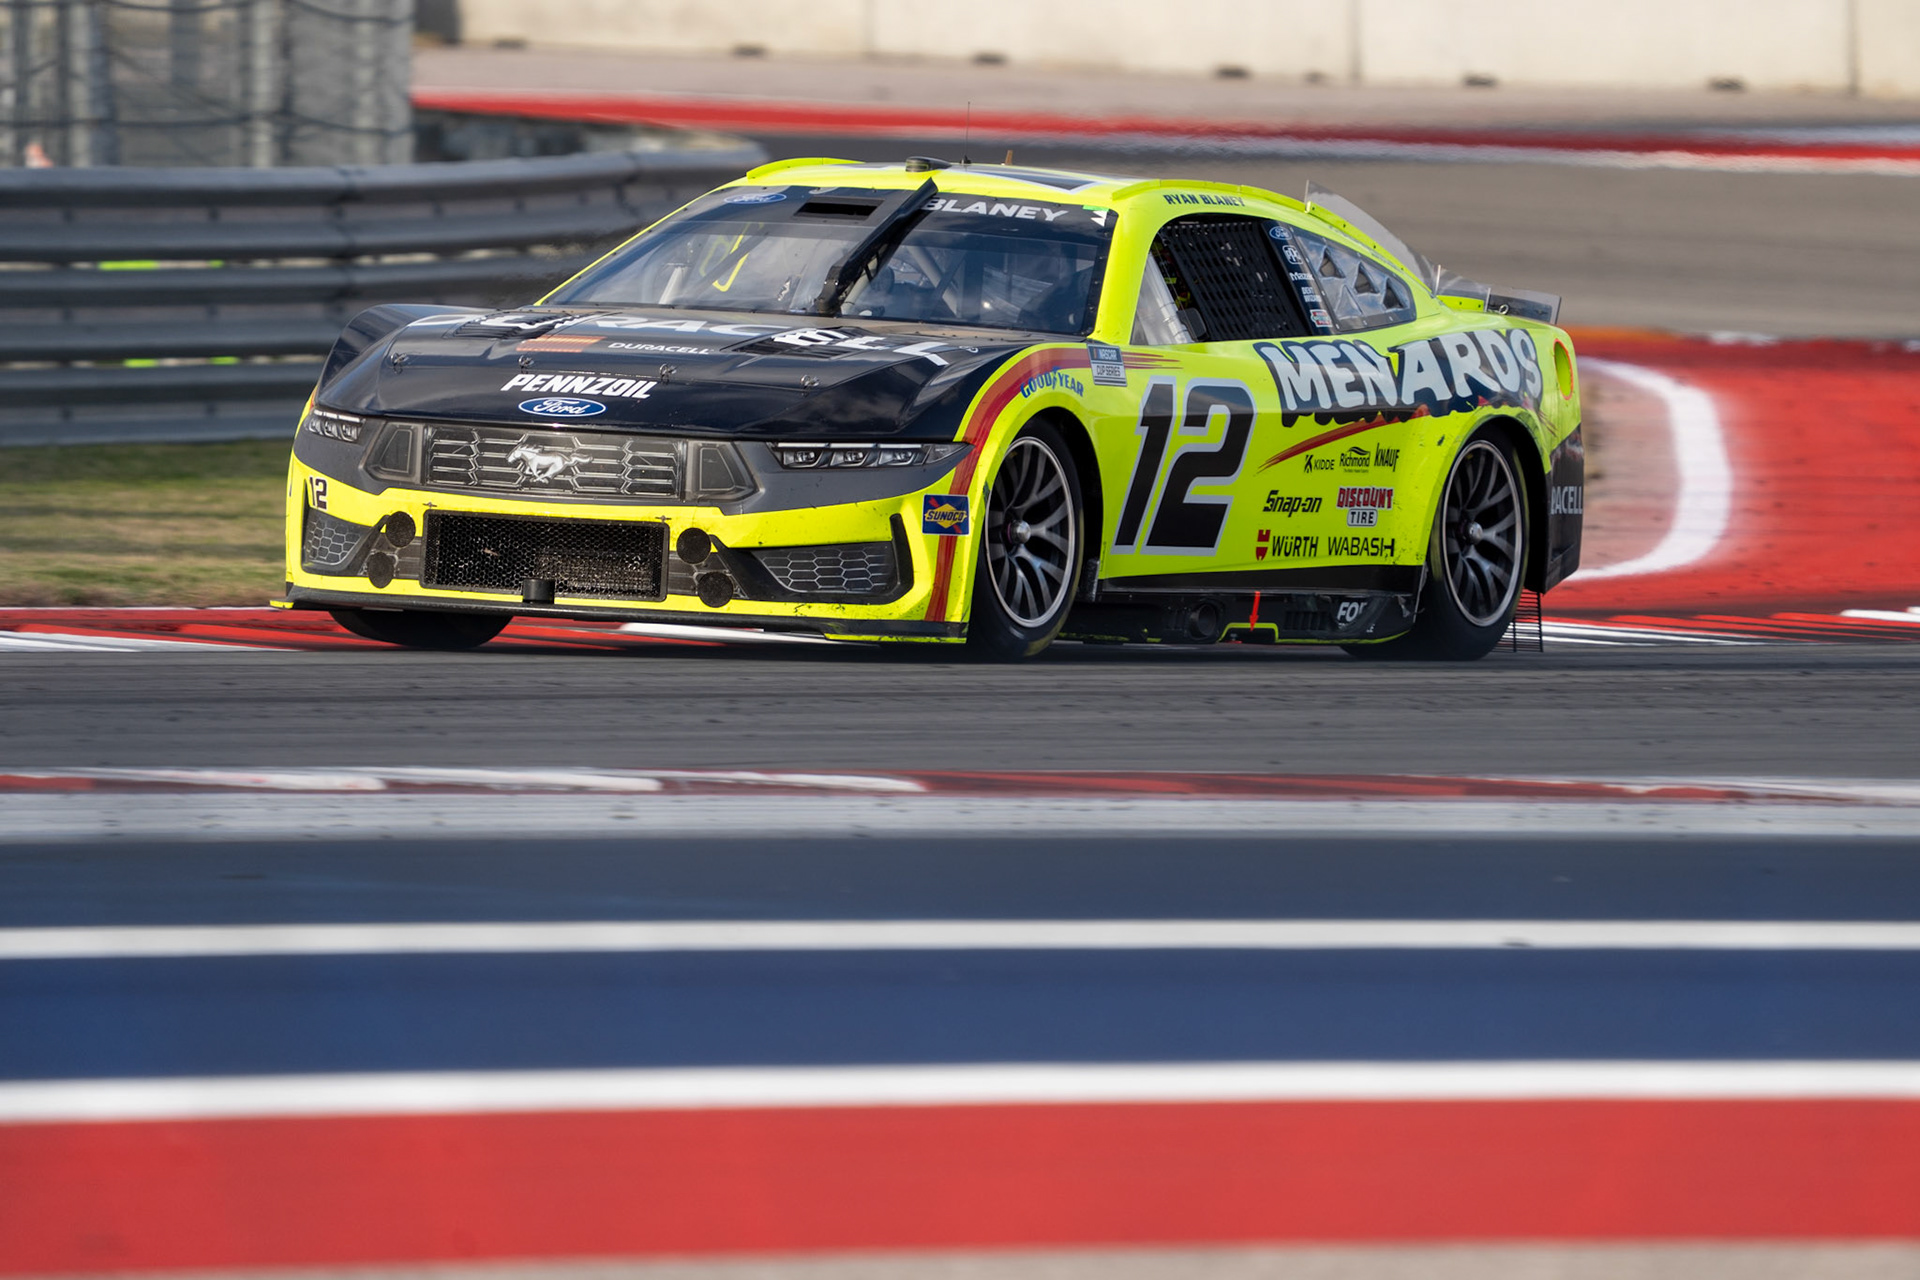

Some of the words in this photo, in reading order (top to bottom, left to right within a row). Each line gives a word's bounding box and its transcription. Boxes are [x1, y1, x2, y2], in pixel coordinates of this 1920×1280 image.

[922, 198, 1068, 222] BLANEY
[1163, 194, 1199, 205] RYAN
[1199, 194, 1245, 207] BLANEY
[608, 342, 711, 355] DURACELL
[1259, 329, 1542, 411] MENARDS
[500, 373, 660, 399] PENNZOIL
[531, 398, 592, 414] Ford
[1111, 375, 1257, 556] 12
[1314, 459, 1335, 471] KIDDE
[1339, 452, 1370, 467] Richmond
[1374, 442, 1400, 472] KNAUF
[309, 476, 327, 510] 12
[1262, 489, 1323, 518] Snap-on
[1336, 486, 1394, 509] DISCOUNT
[926, 510, 965, 522] SUNOCO
[1350, 510, 1374, 524] TIRE
[1328, 536, 1395, 558] WABASH
